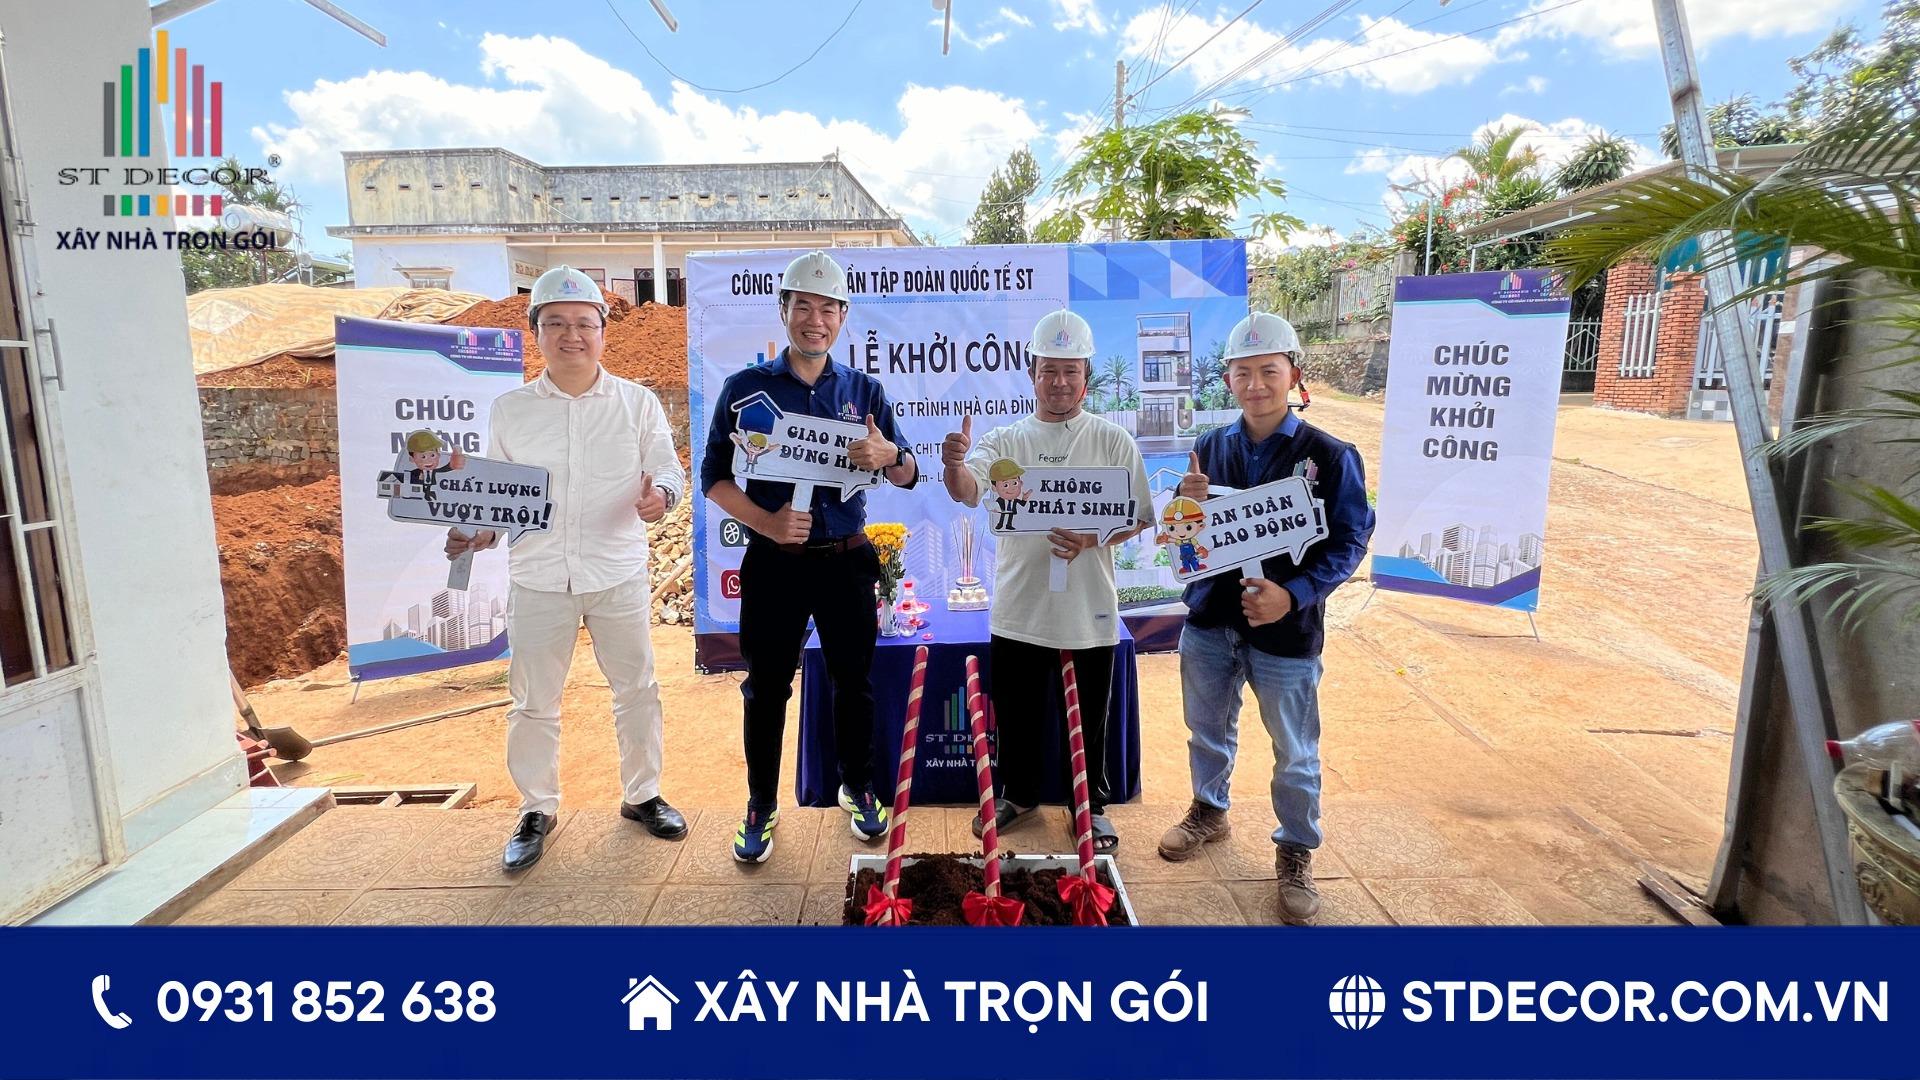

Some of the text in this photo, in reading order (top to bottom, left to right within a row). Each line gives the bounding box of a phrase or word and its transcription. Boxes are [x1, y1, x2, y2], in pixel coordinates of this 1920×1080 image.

[732, 269, 773, 295] CÔNG
[846, 264, 867, 293] ẦN
[871, 266, 899, 298] TẬP
[904, 265, 945, 293] ĐOÀN
[950, 261, 990, 294] QUỐC
[994, 261, 1011, 290] TẾ
[1016, 268, 1034, 290] ST
[850, 330, 880, 374] LỄ
[889, 332, 957, 374] KHỞI
[1433, 340, 1510, 366] CHÚC
[1426, 372, 1511, 397] MỪNG
[395, 395, 475, 421] CHÚC
[908, 397, 949, 416] TRÌNH
[954, 395, 982, 416] NHÀ
[985, 399, 1008, 415] GIA
[1011, 394, 1038, 415] ĐÌN
[1429, 401, 1495, 429] KHỞI
[391, 427, 480, 454] MNG
[787, 425, 830, 444] GIAO
[779, 445, 830, 465] ĐÚNG
[916, 443, 932, 457] CHỊ
[1422, 435, 1498, 462] CÔNG
[439, 475, 541, 498] CHẤT LƯỢNG
[1040, 478, 1103, 494] KHÔNG
[427, 501, 484, 523] VƯỢT
[1028, 499, 1077, 515] PHÁT
[1211, 495, 1294, 527] AN TOÀN
[1211, 527, 1249, 549] LAO
[926, 734, 947, 743] ST
[926, 757, 997, 768] XÂY NHÀ TN
